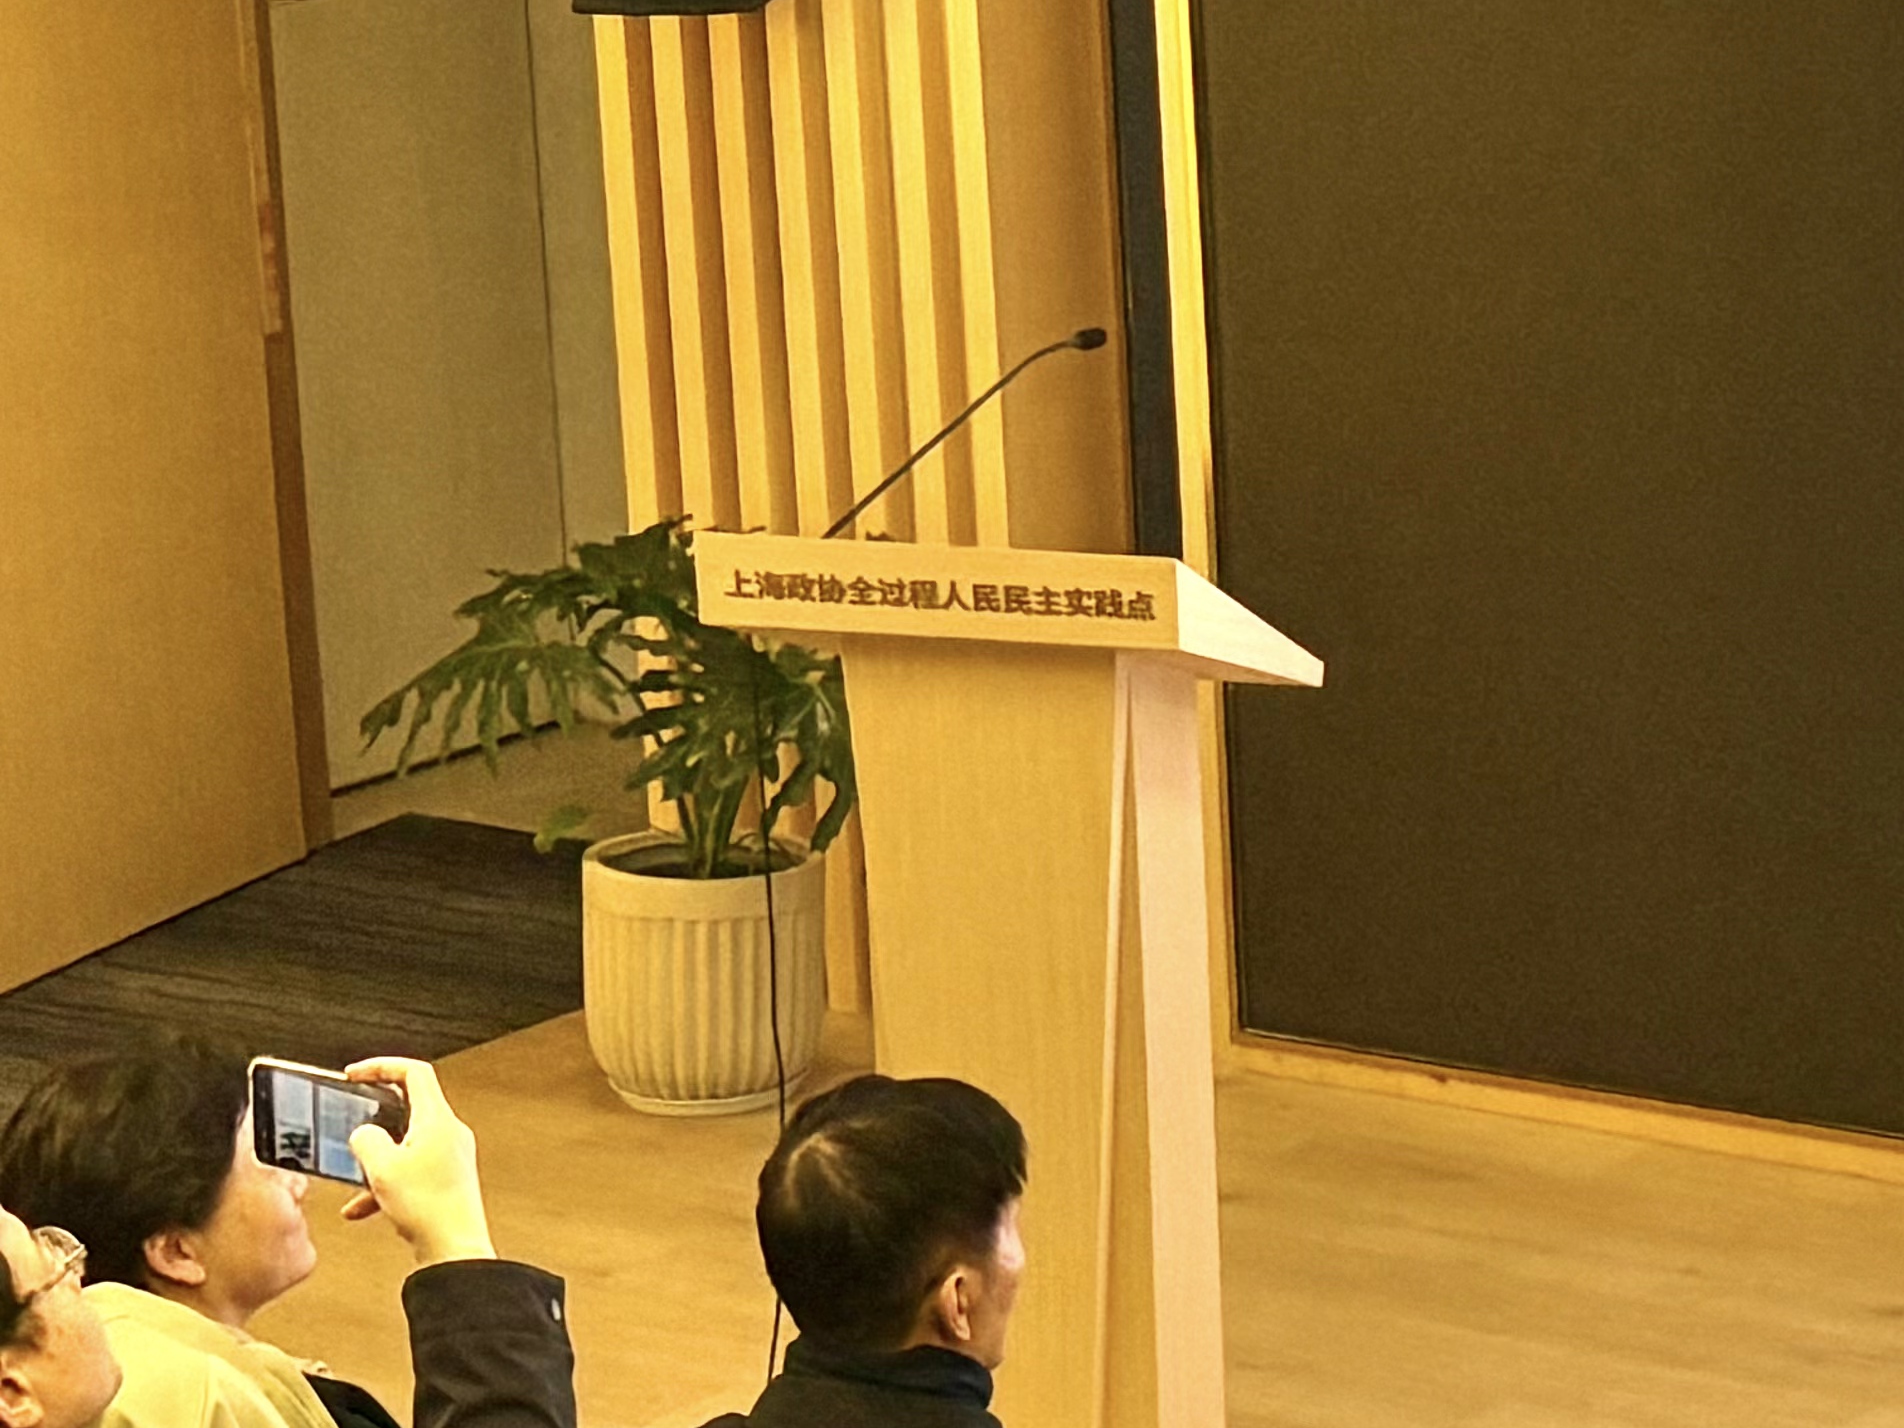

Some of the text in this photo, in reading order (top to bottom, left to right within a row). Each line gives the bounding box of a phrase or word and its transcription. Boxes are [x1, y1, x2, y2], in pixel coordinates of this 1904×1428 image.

[723, 569, 1156, 622] 上海政协全过程人民民主实践点
